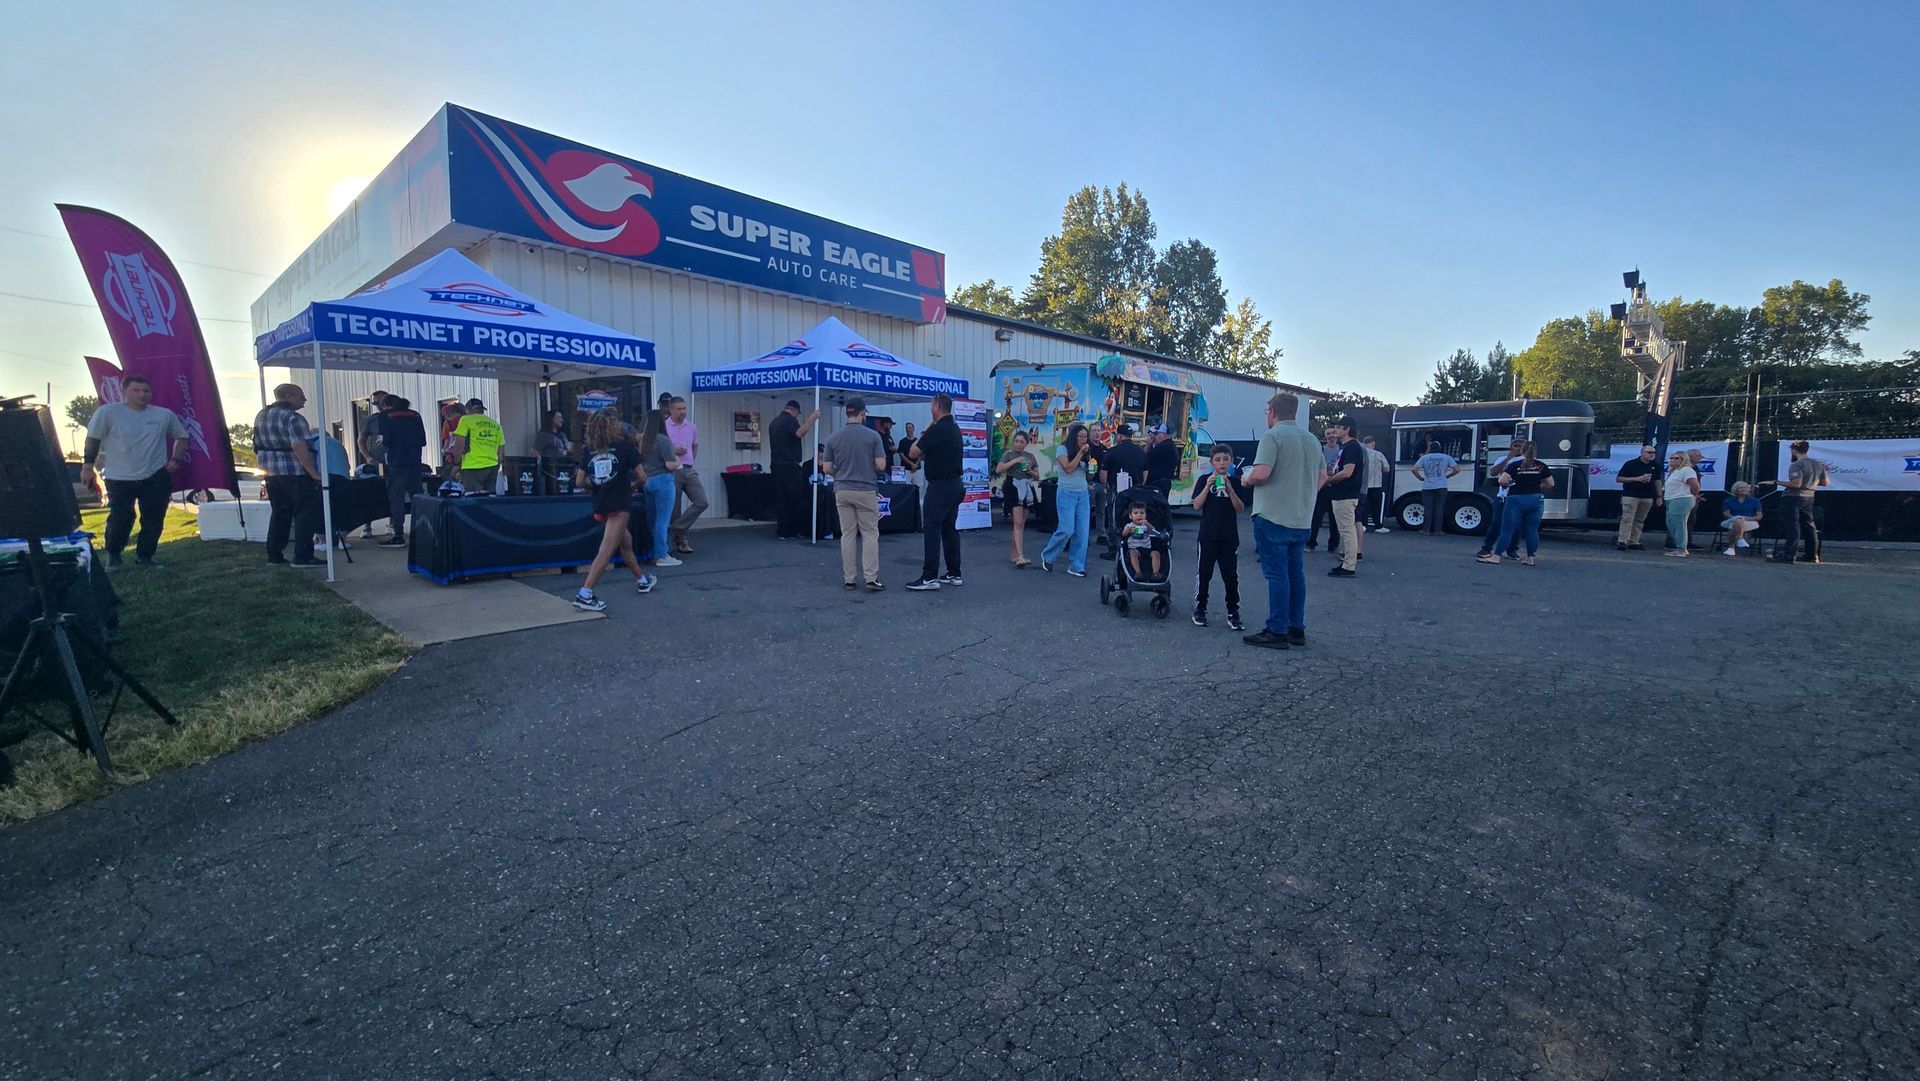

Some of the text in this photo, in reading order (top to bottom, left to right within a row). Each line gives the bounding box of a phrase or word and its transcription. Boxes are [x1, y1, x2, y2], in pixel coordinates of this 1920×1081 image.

[690, 204, 911, 282] SUPER EAGLE
[767, 257, 857, 289] AUTO CARE
[121, 259, 157, 329] TECHNET
[436, 292, 528, 309] TECHNET
[327, 311, 463, 343] TECHNET
[474, 327, 647, 363] PROFESSIONAL
[694, 367, 812, 388] TECHNET PROFESSIONAL
[824, 367, 966, 396] TECHNET PROFESSIONAL
[1029, 391, 1049, 400] KONA
